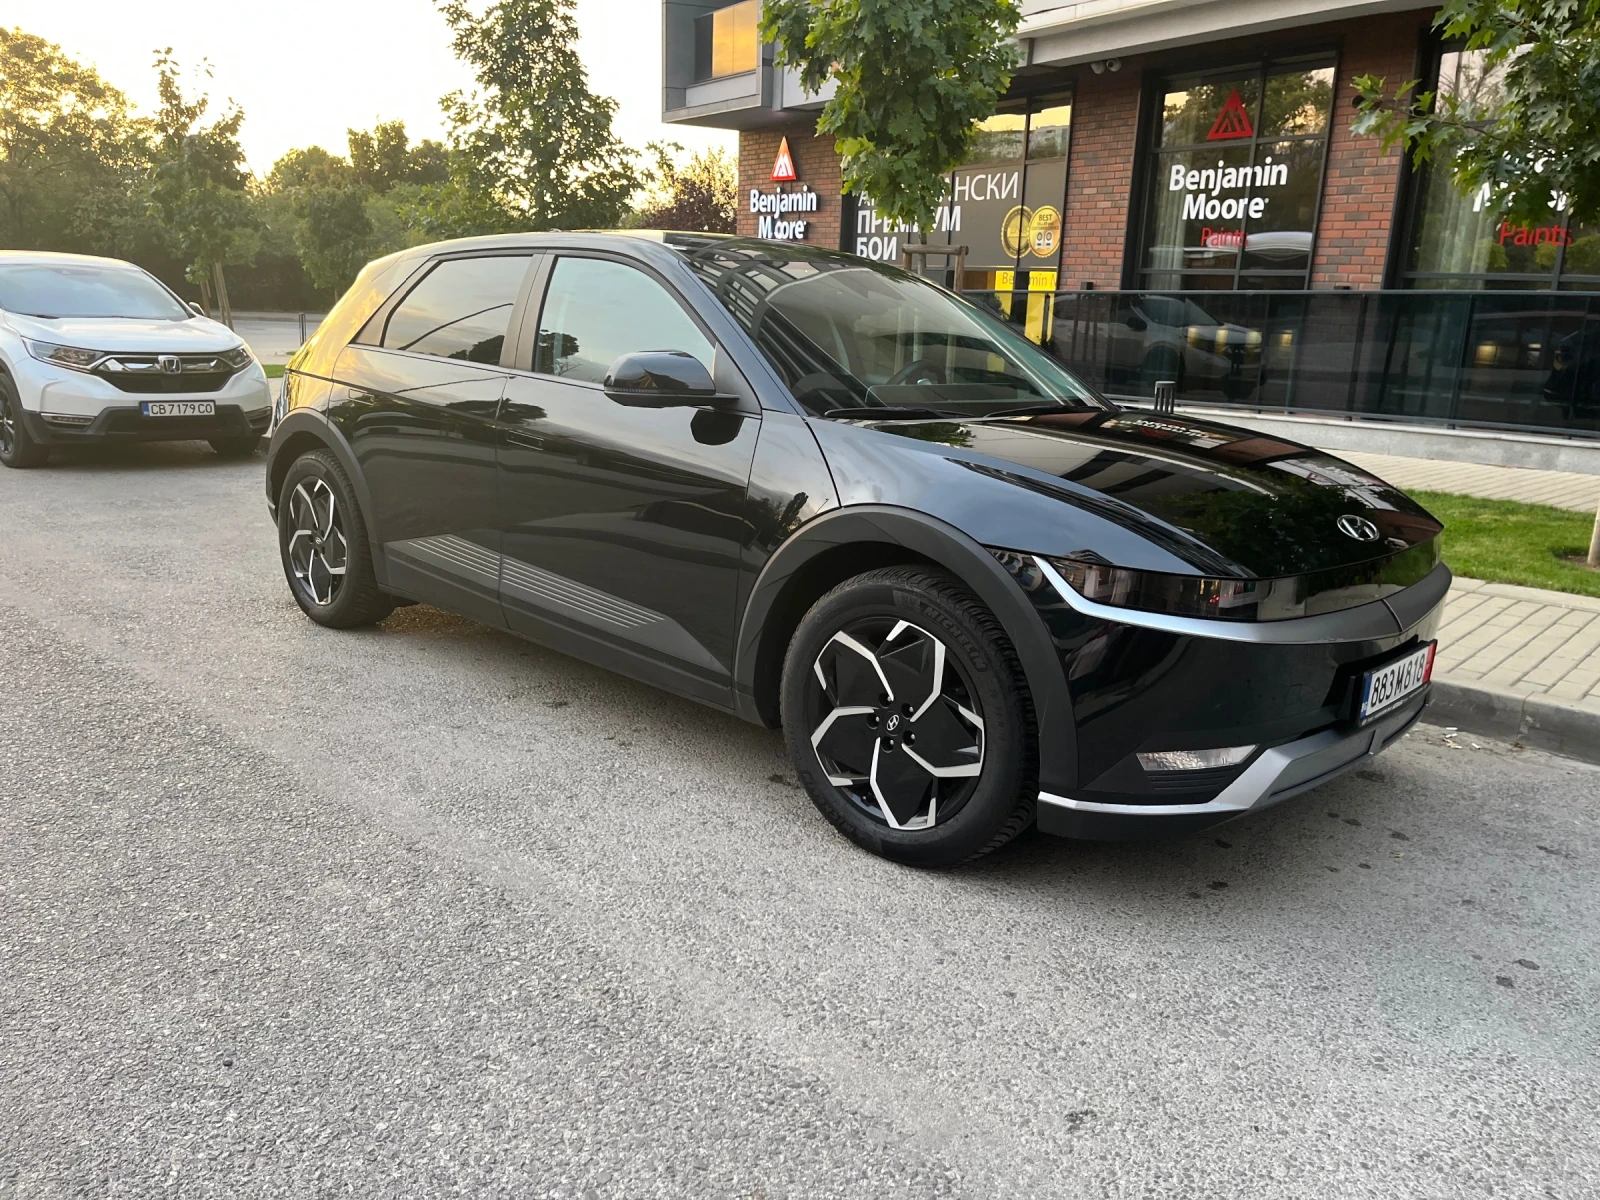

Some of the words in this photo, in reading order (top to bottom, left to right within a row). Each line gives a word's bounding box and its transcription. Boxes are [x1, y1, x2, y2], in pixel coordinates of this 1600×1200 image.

[1169, 156, 1288, 196] Benjamin
[750, 185, 817, 219] Benjamin
[1182, 193, 1266, 220] Moore
[1039, 214, 1053, 222] BEST
[1201, 227, 1249, 247] Paints
[1499, 221, 1572, 246] Paints
[856, 236, 897, 261] БОИ
[923, 605, 987, 670] MICHELIN
